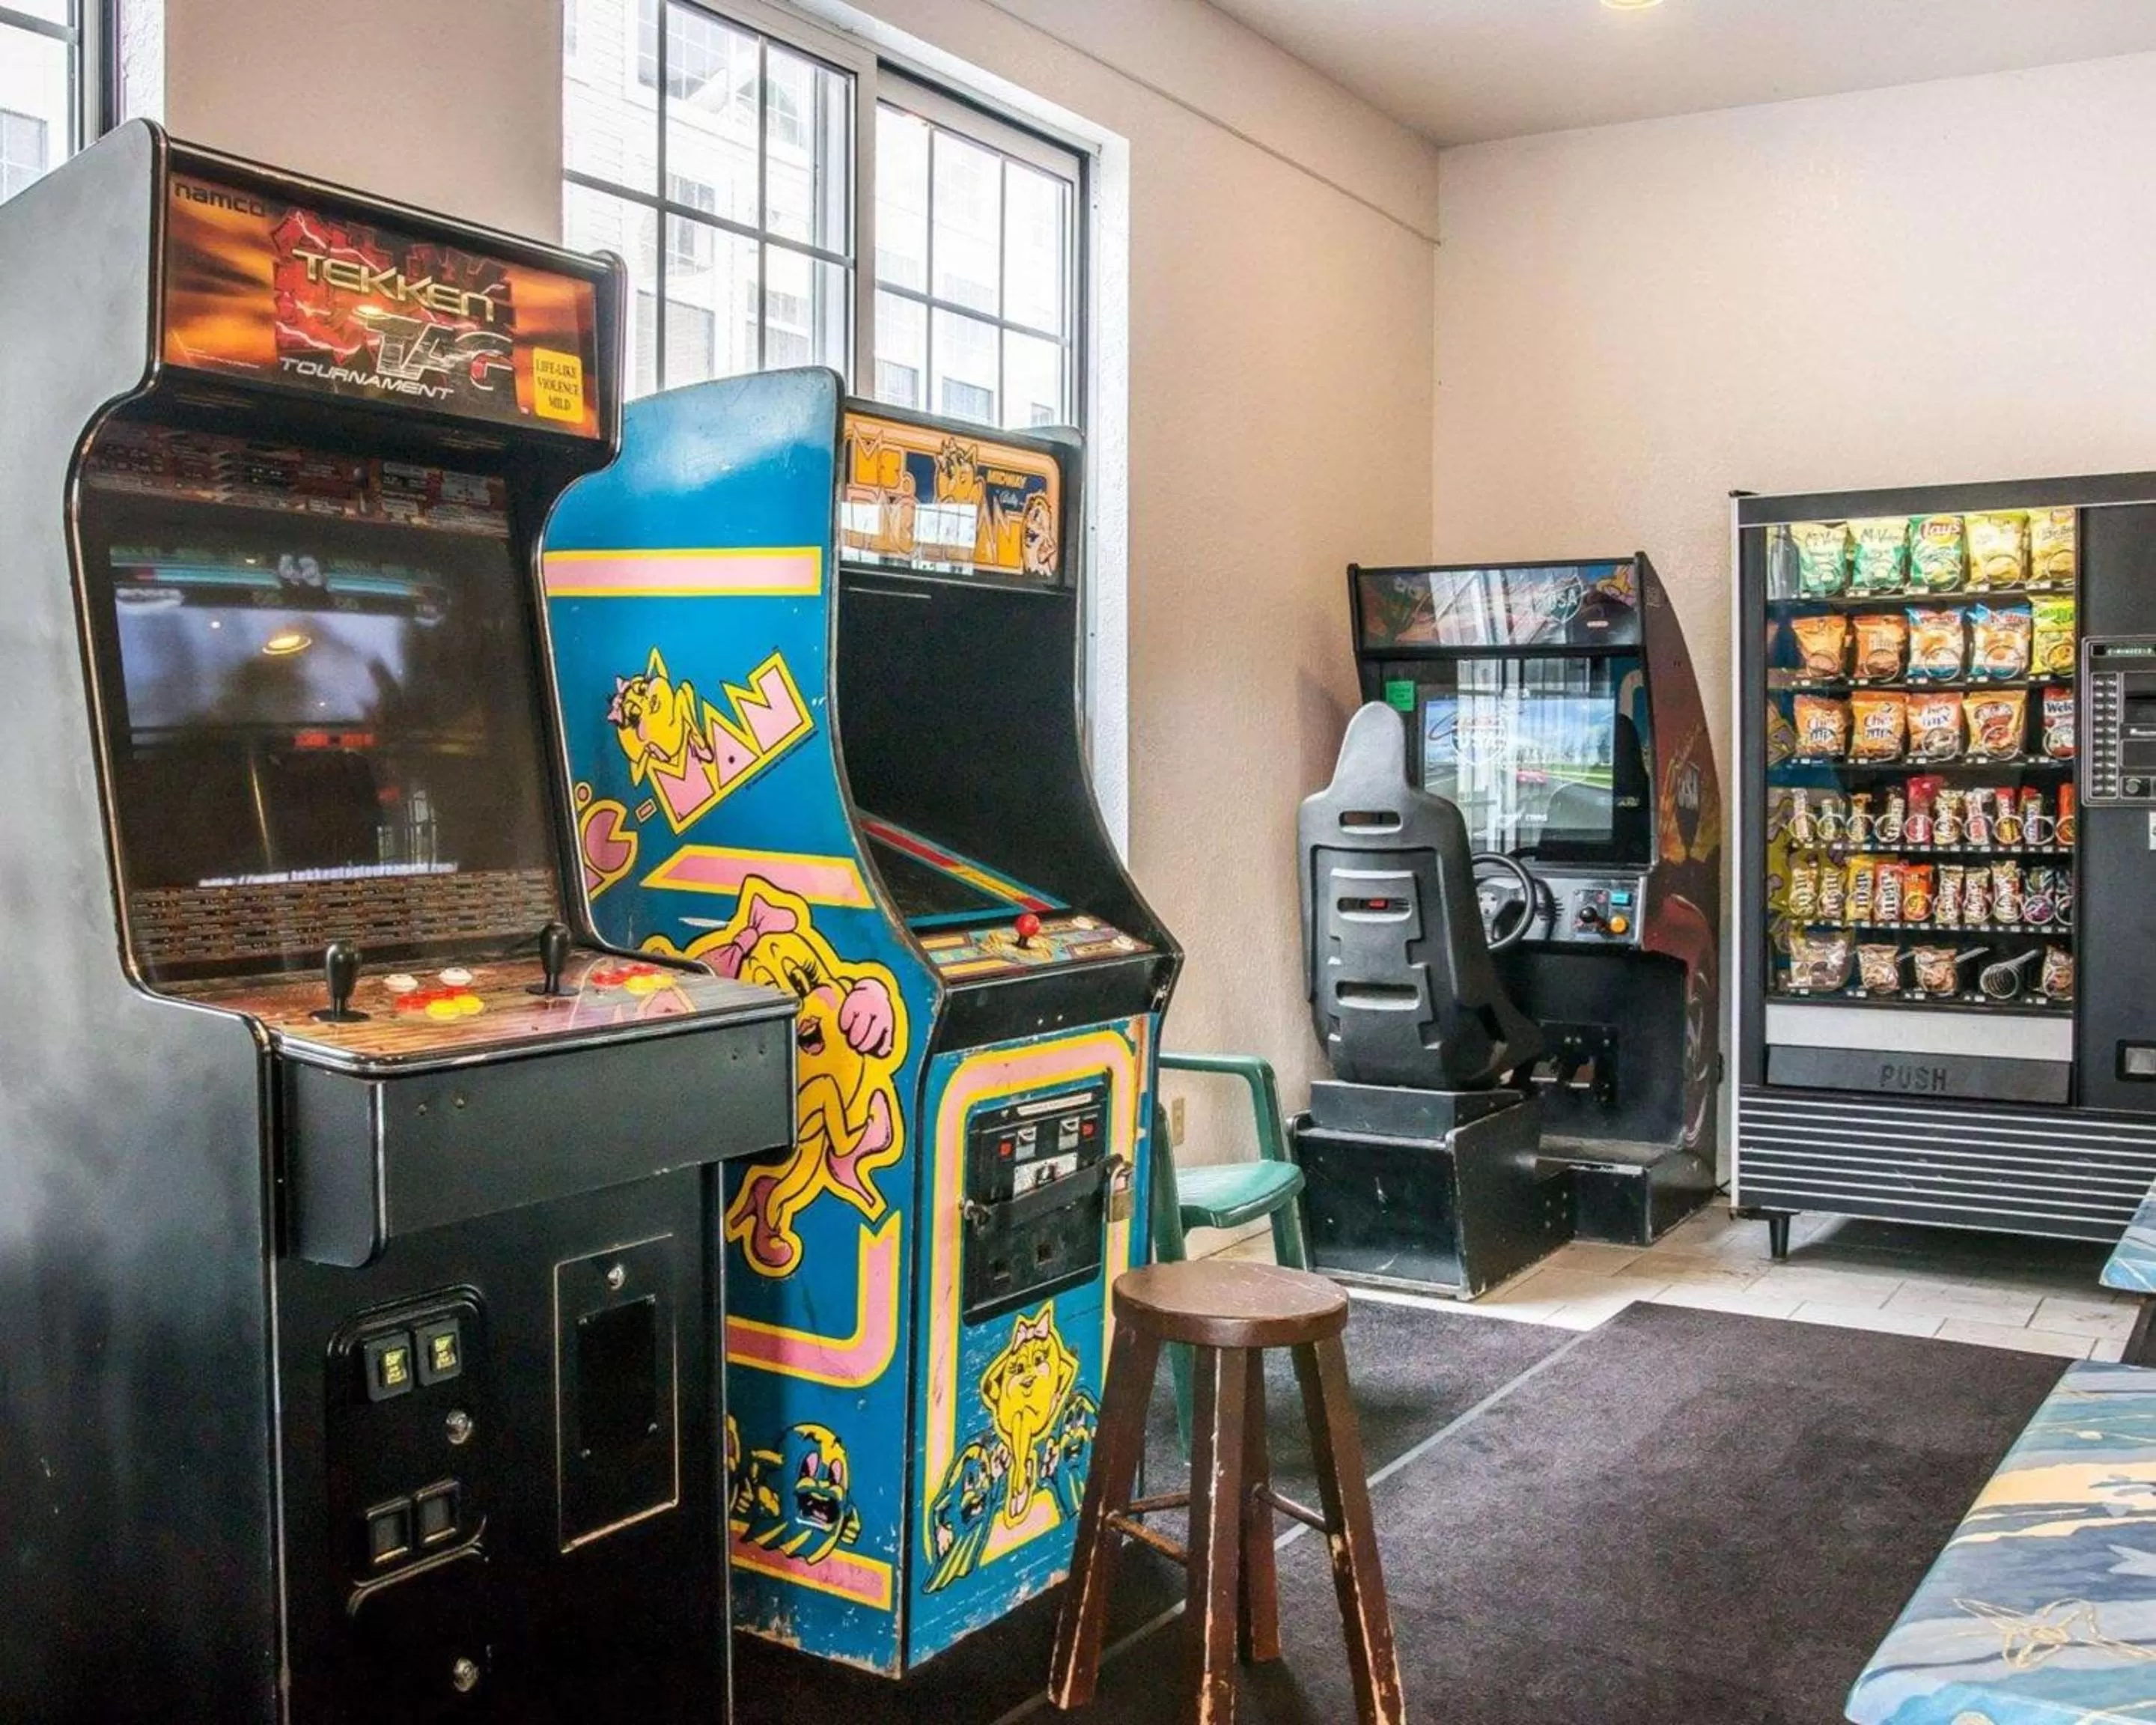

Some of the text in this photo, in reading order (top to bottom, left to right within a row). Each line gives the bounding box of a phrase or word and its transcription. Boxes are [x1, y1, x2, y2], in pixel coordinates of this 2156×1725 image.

[174, 183, 267, 217] namco
[278, 356, 454, 401] TOURNAMENT
[536, 376, 579, 396] VIOLENCE
[548, 394, 571, 412] MILD
[1879, 1065, 1947, 1092] PUSH
